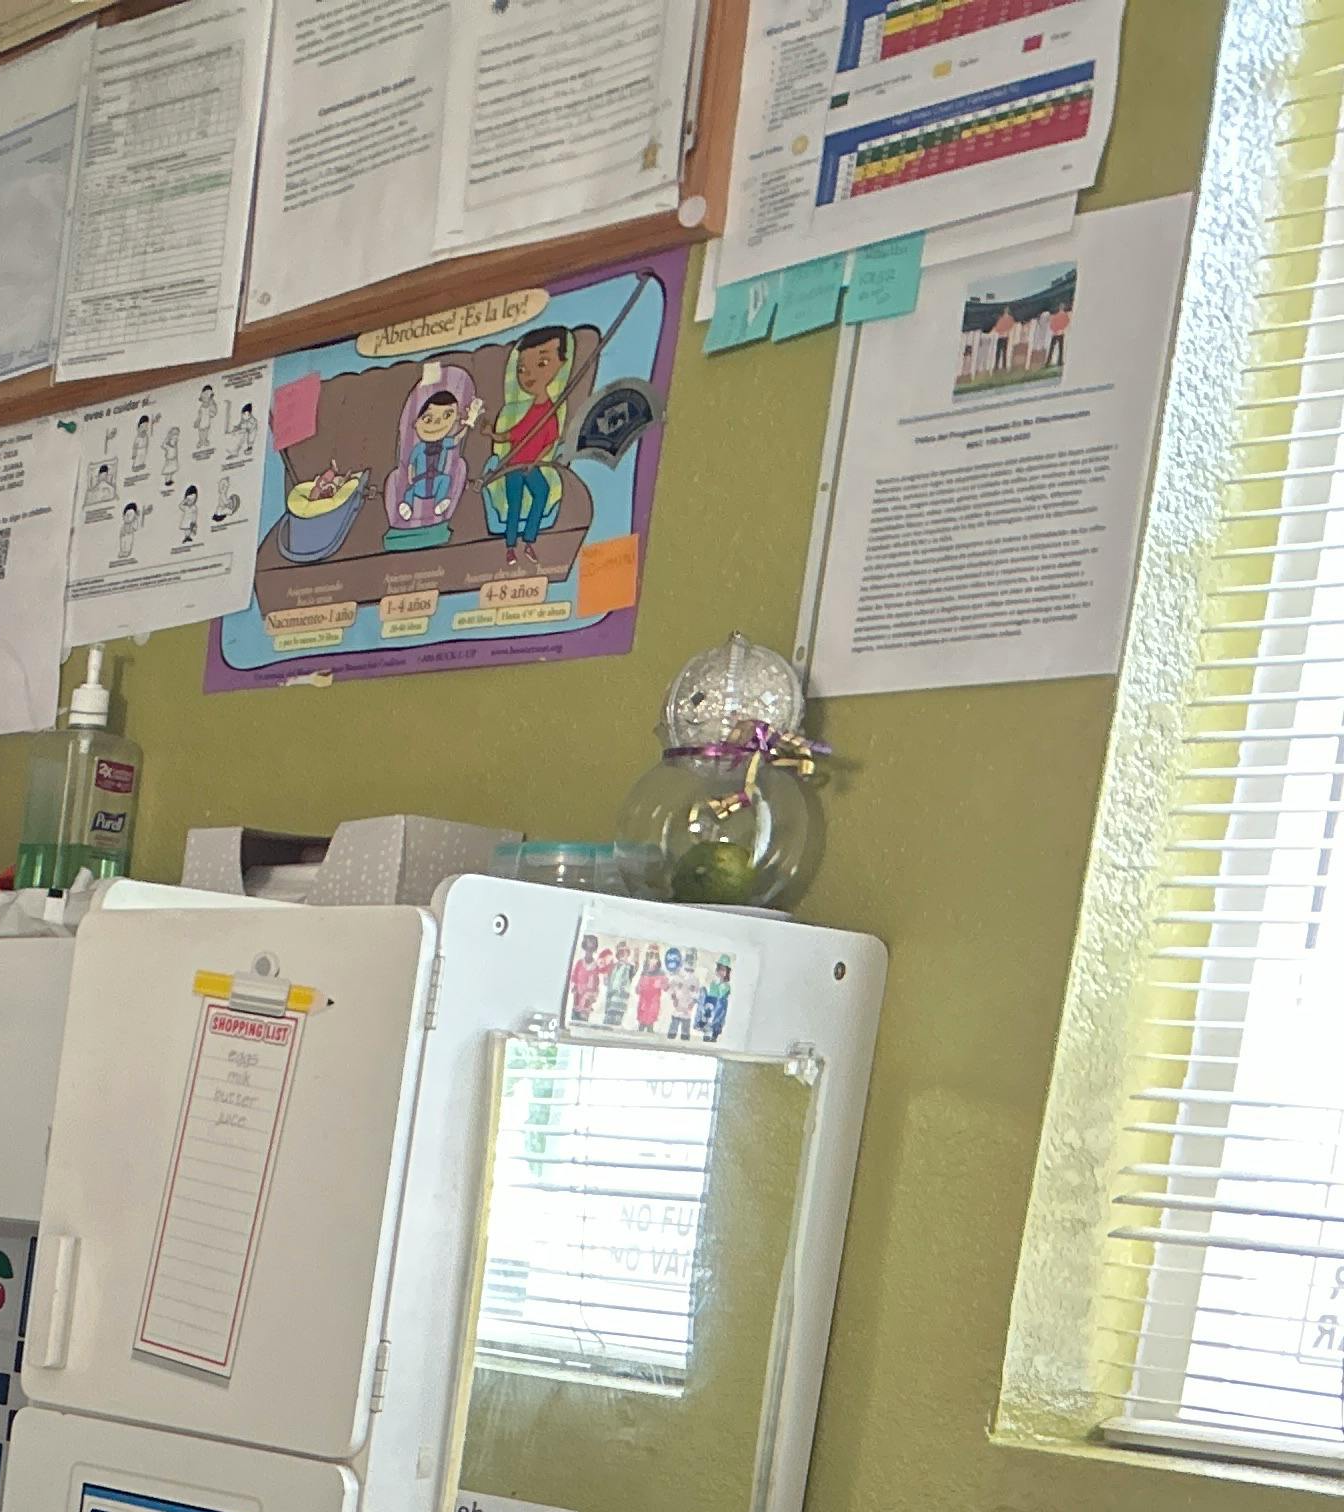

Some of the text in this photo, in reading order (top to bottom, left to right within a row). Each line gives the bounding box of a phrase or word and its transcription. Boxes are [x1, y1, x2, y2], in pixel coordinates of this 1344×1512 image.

[458, 303, 483, 336] ¡Es
[485, 300, 497, 322] la
[501, 294, 530, 322] ley!
[484, 584, 540, 602] 4-8 años
[333, 608, 355, 623] año
[386, 596, 432, 614] 1-4 años
[212, 1015, 289, 1042] SHOPPING LIST
[622, 1204, 653, 1233] NO
